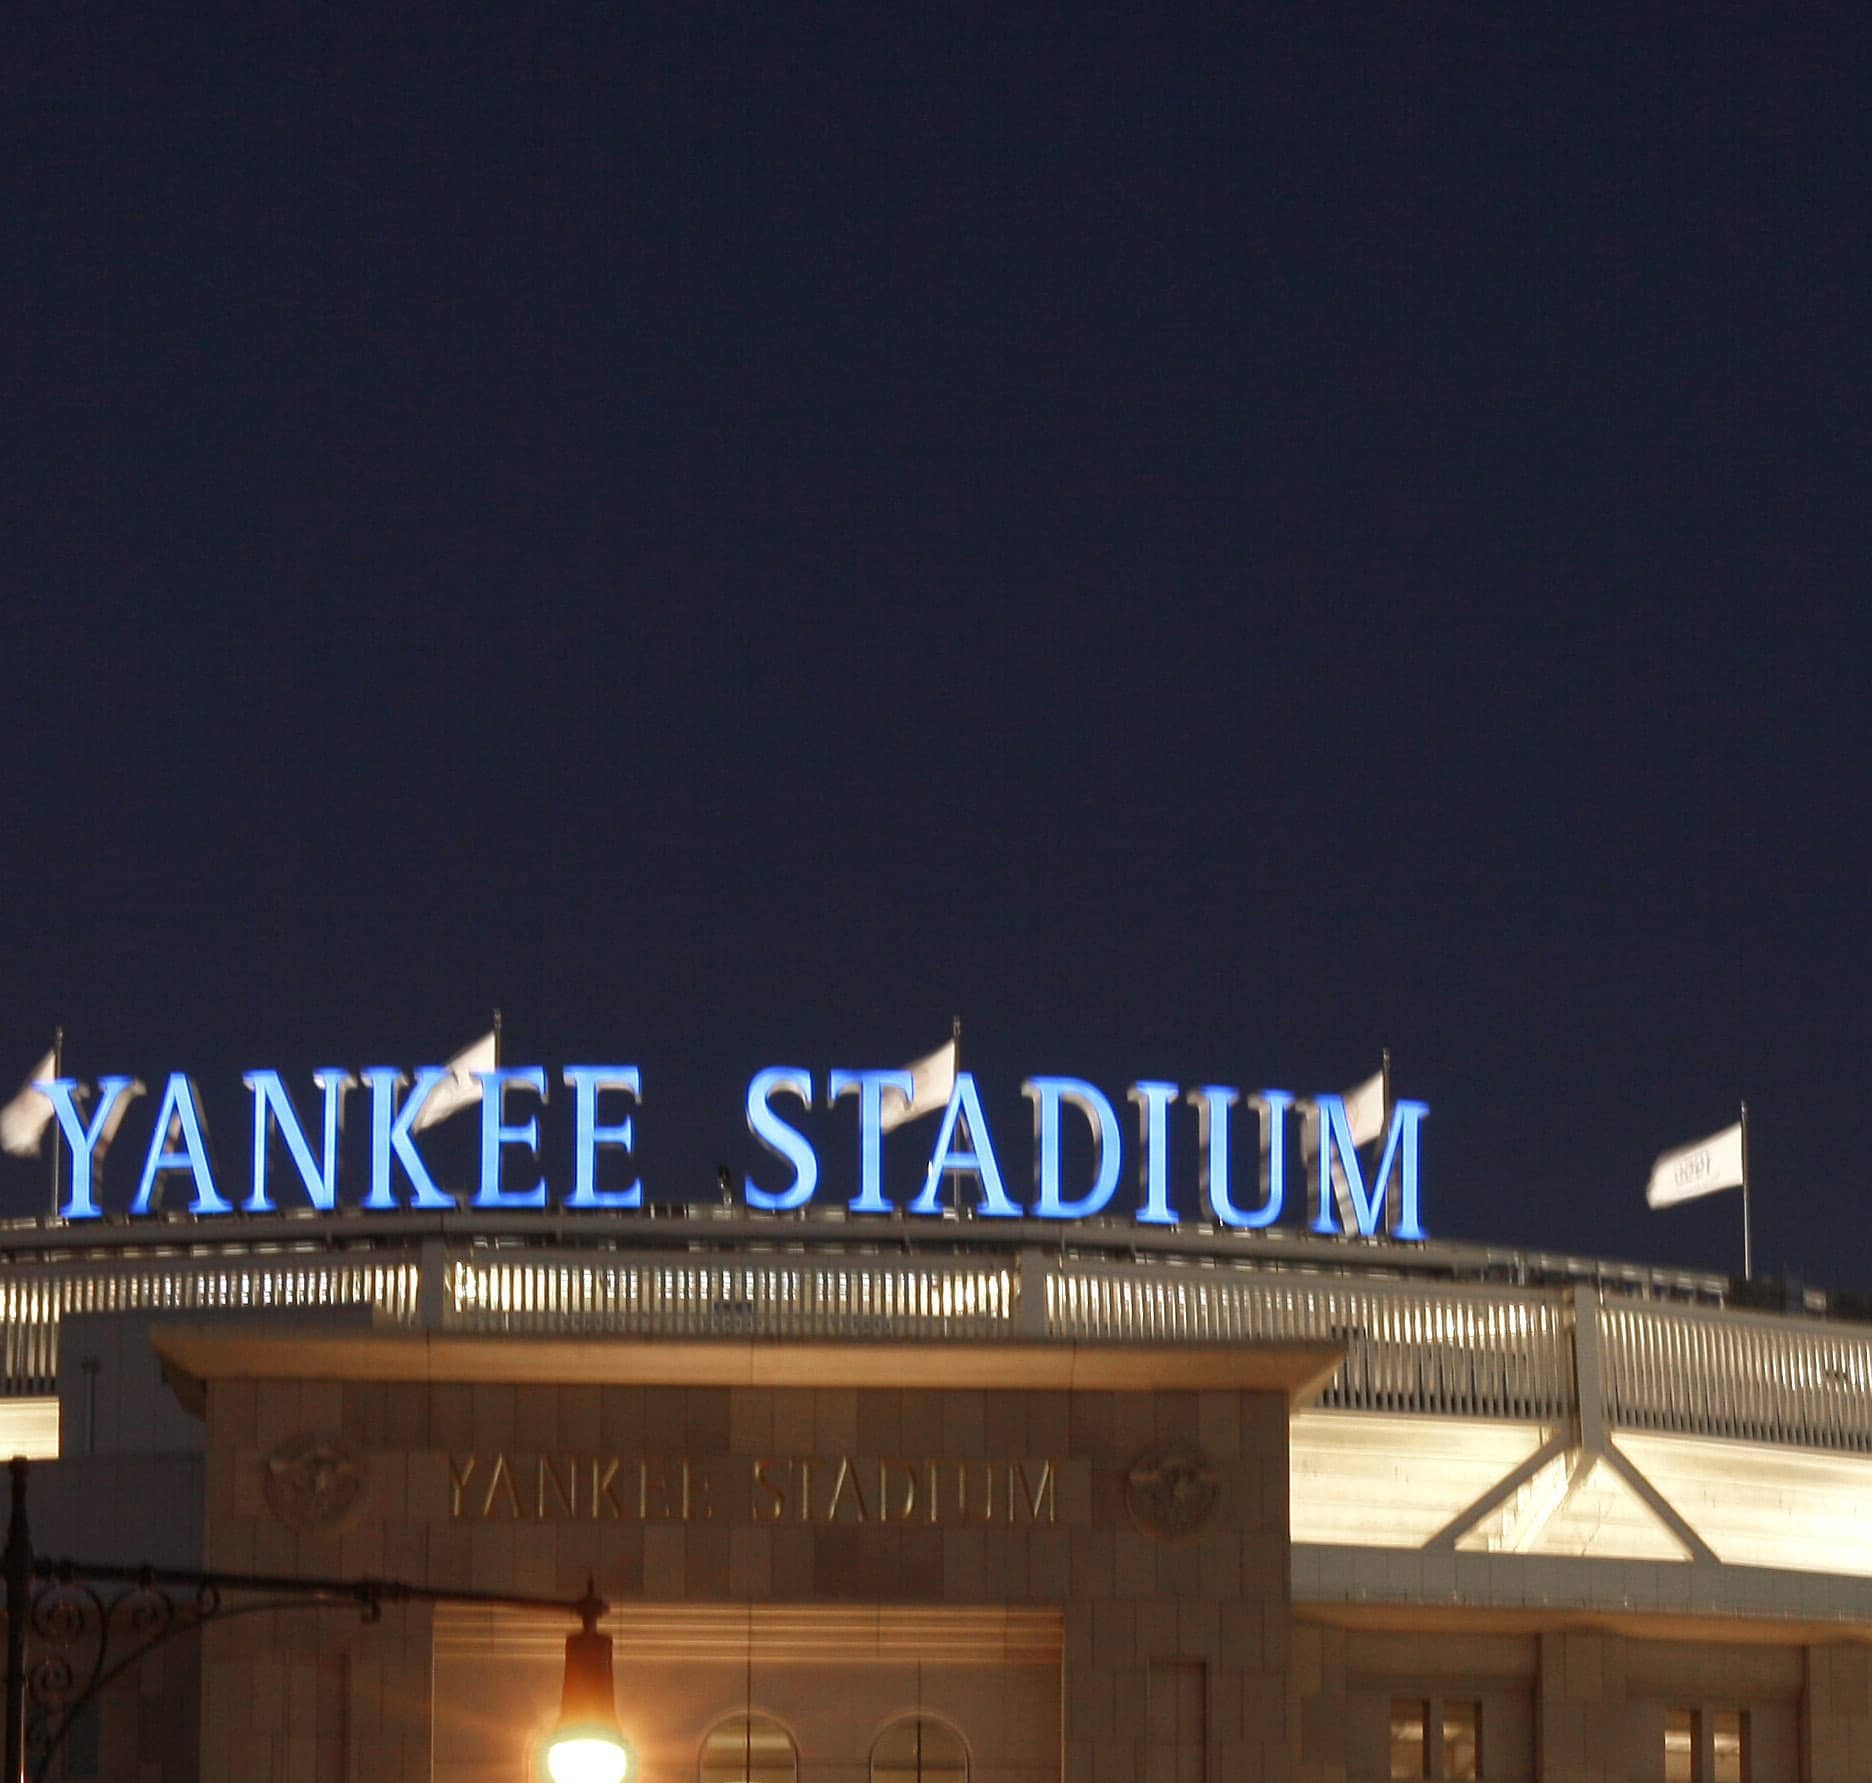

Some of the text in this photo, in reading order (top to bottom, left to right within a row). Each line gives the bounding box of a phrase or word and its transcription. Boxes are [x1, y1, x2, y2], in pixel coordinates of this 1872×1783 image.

[33, 1064, 1429, 1241] YANKEE STADIUM
[448, 1453, 1059, 1523] YANKEE STADIUM
